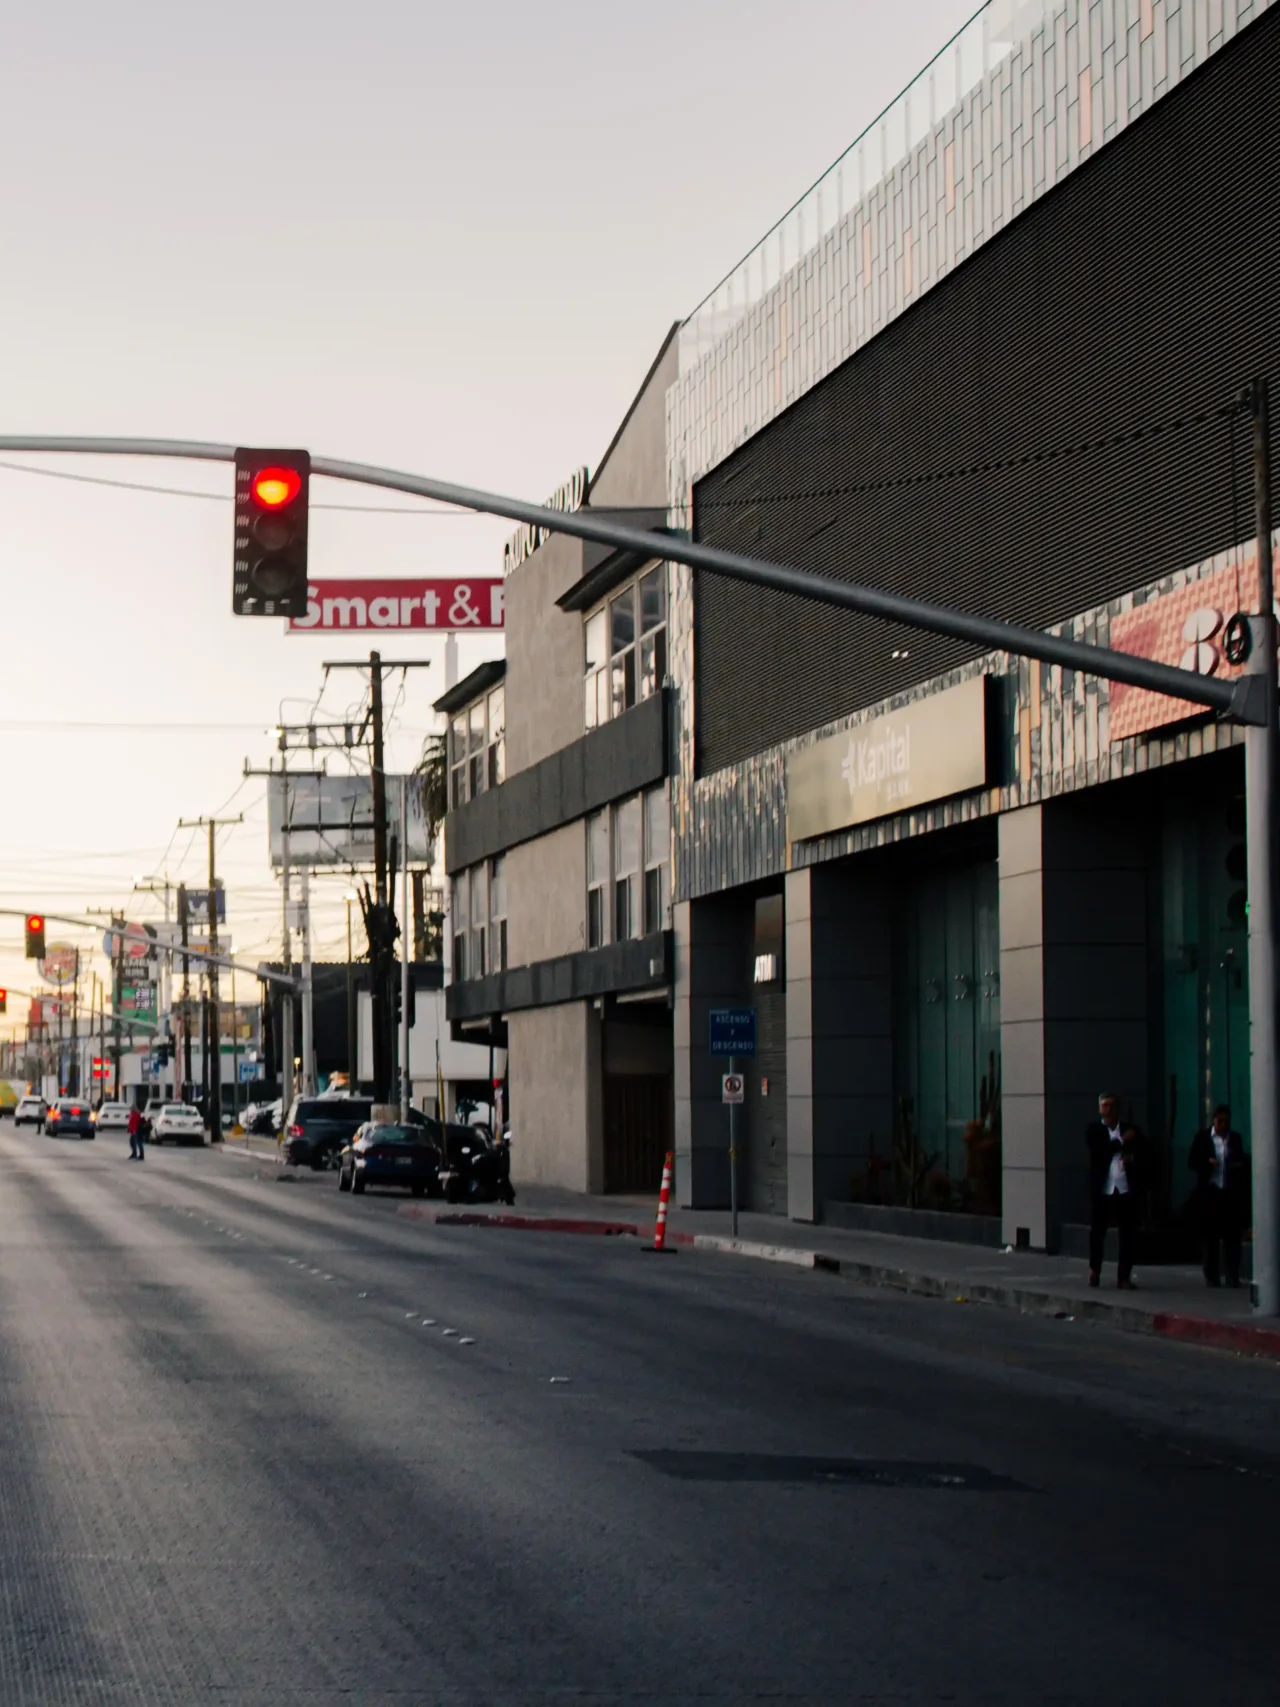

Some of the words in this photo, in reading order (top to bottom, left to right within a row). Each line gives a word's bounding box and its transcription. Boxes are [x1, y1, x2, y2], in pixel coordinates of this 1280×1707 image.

[293, 585, 441, 627] Smart
[448, 584, 481, 626] &
[857, 723, 911, 792] Kapital
